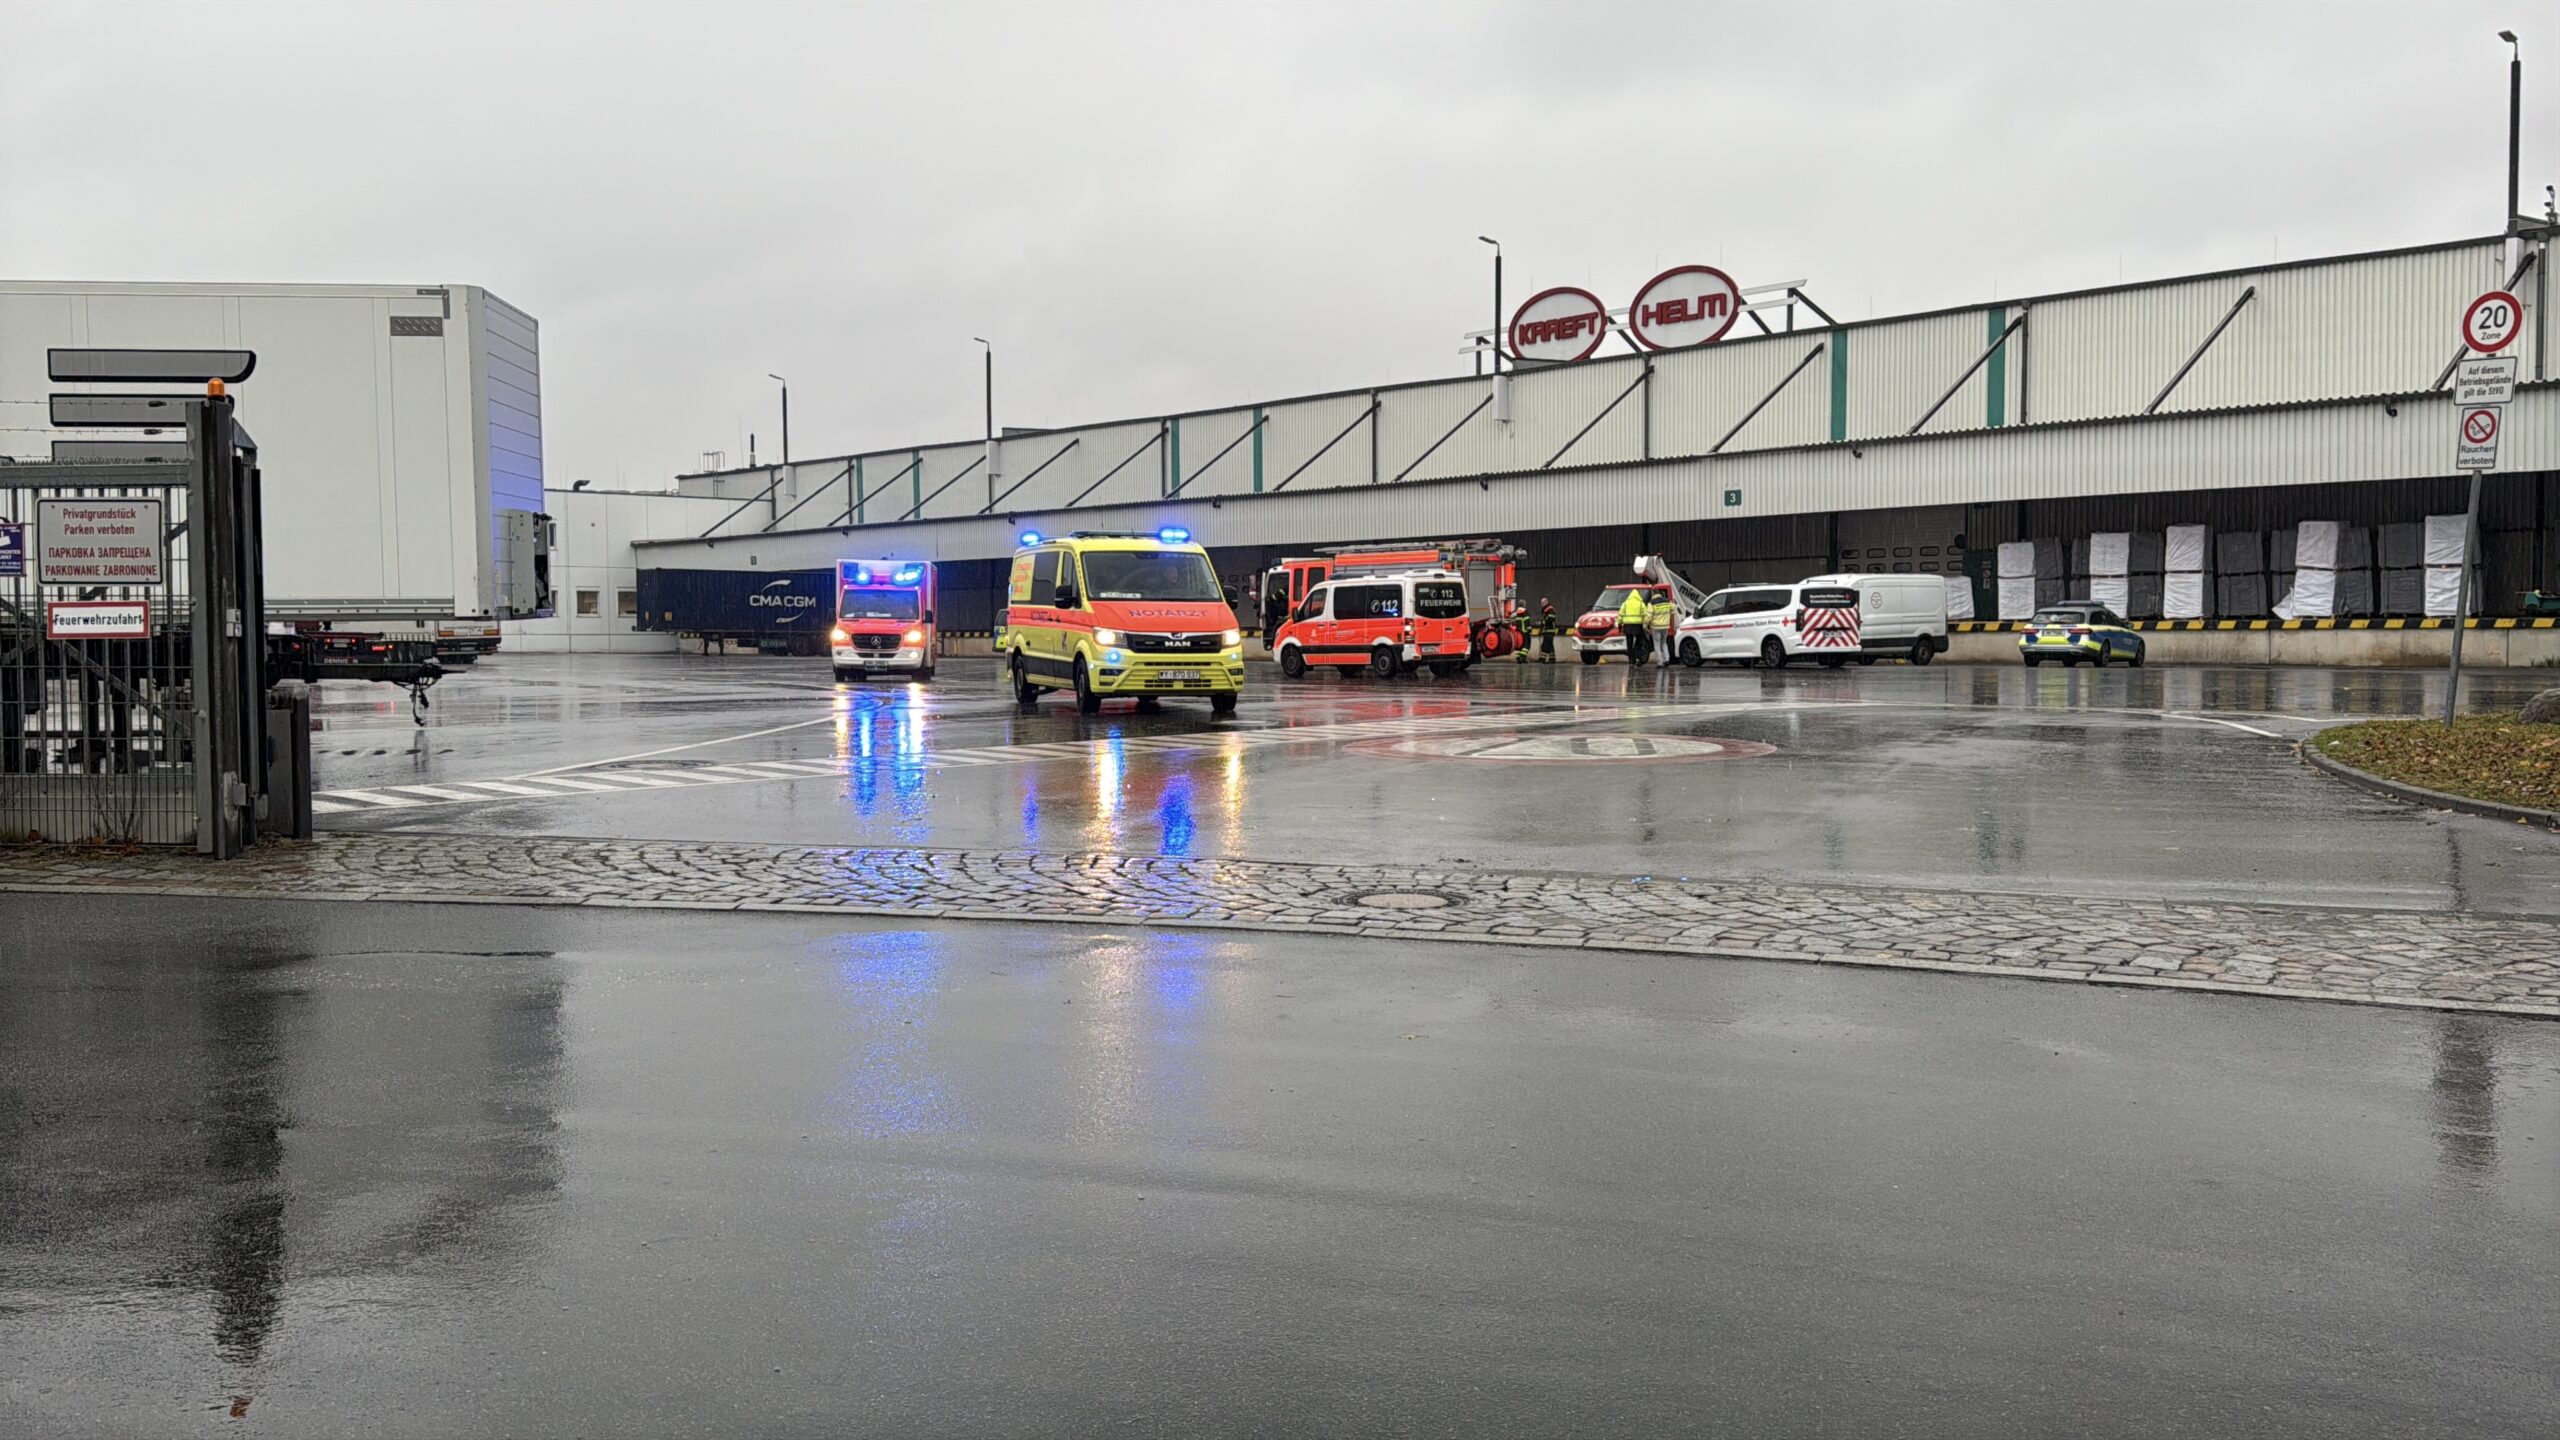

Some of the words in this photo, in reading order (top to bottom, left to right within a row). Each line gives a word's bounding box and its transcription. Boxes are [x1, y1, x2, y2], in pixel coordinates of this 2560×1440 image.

[1641, 293, 1727, 327] HELM
[2478, 305, 2508, 330] 20
[2481, 332, 2501, 341] Zone
[2468, 366, 2480, 375] Auf
[2481, 365, 2505, 374] diesem
[2459, 376, 2512, 387] Betriebsgelände
[2463, 387, 2476, 399] gilt
[2477, 386, 2487, 396] die
[2488, 386, 2504, 396] StVO
[2461, 445, 2495, 454] Rauchen
[2459, 455, 2494, 465] verboten
[1730, 492, 1736, 503] 3
[63, 508, 136, 521] Privatgrundstück
[64, 524, 95, 535] Parken
[98, 524, 135, 535] verboten
[48, 547, 95, 559] ПАРКОВКА
[98, 547, 152, 560] ЗАПРЕЩЕНА
[45, 564, 100, 577] PARKOWANIE
[103, 564, 158, 577] ZABRONIONE
[1440, 589, 1454, 598] 112
[749, 594, 783, 607] CMA
[784, 596, 816, 607] CGM
[1381, 600, 1398, 612] 112
[1129, 609, 1207, 617] NOTARZT
[54, 613, 143, 626] Feuerwehrzufahrt
